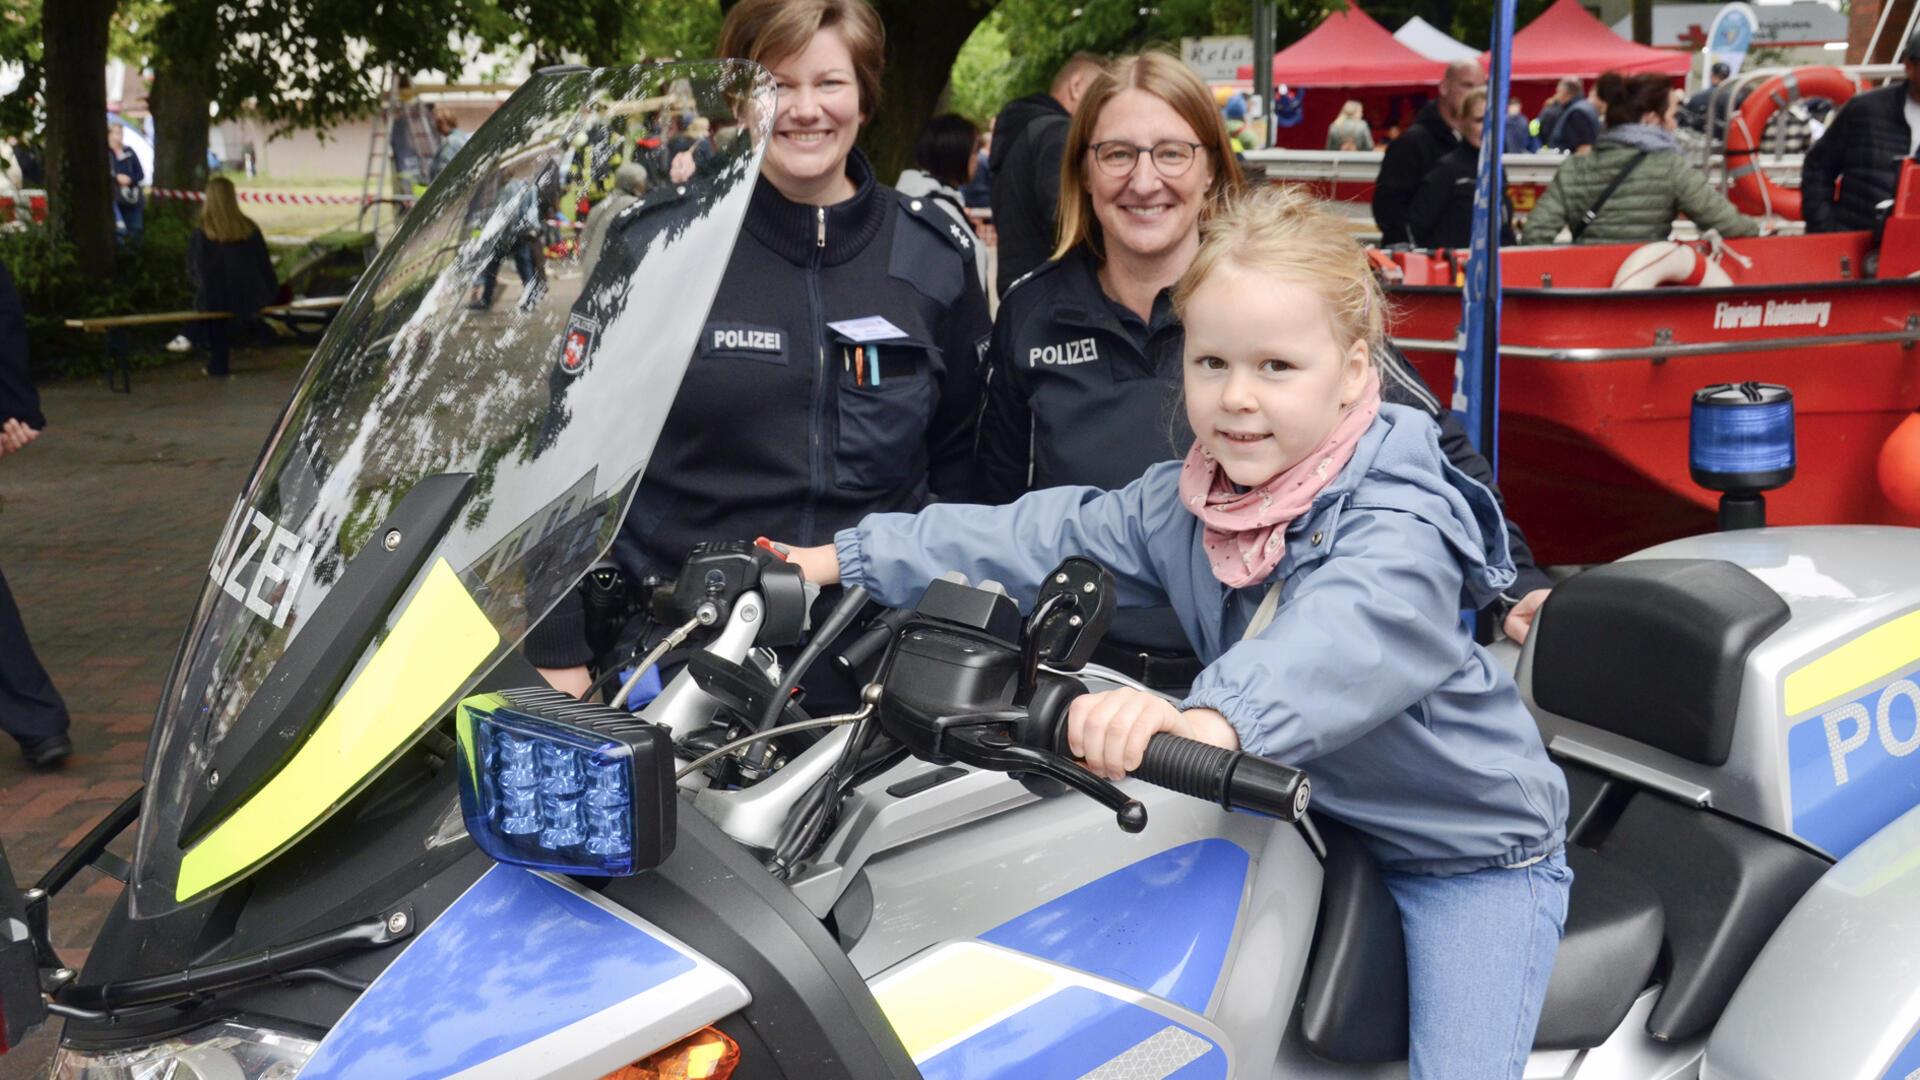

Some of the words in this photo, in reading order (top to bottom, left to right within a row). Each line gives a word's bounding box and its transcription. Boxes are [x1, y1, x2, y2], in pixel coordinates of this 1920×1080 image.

[1713, 301, 1763, 329] Florian
[1763, 299, 1831, 328] Rotenburg
[714, 330, 781, 349] POLIZEI
[1029, 337, 1099, 367] POLIZEI
[1821, 679, 1920, 786] PO
